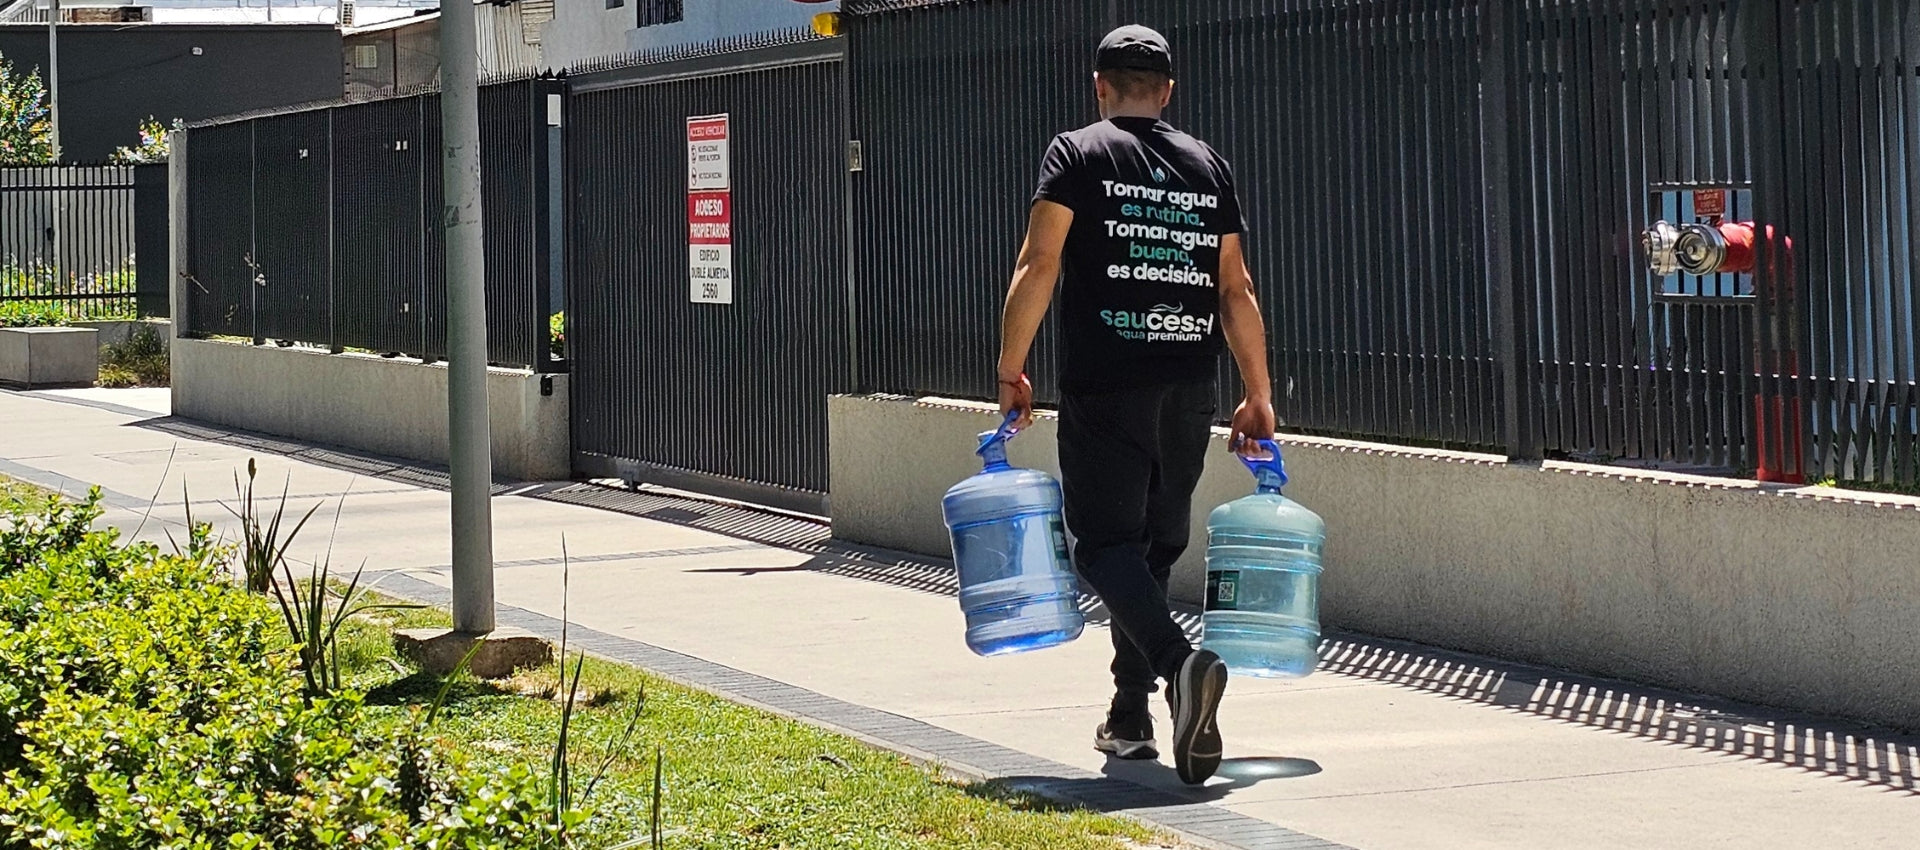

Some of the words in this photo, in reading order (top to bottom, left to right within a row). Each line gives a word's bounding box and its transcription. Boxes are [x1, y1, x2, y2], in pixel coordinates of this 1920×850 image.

[1102, 180, 1166, 202] Tomar
[1168, 192, 1217, 211] agua
[695, 199, 723, 216] ACCESO
[1121, 203, 1142, 217] es
[1146, 205, 1205, 226] rutina.
[690, 222, 730, 238] PROPIETARIOS
[1104, 220, 1168, 240] Tomar
[1170, 233, 1218, 251] agua
[699, 249, 720, 261] EDIFICIO
[1129, 241, 1194, 266] buena,
[707, 267, 729, 279] ALMEYDA
[1107, 264, 1130, 279] es
[1133, 262, 1214, 288] decisión.
[702, 282, 718, 298] 2560
[1147, 330, 1202, 343] premium
